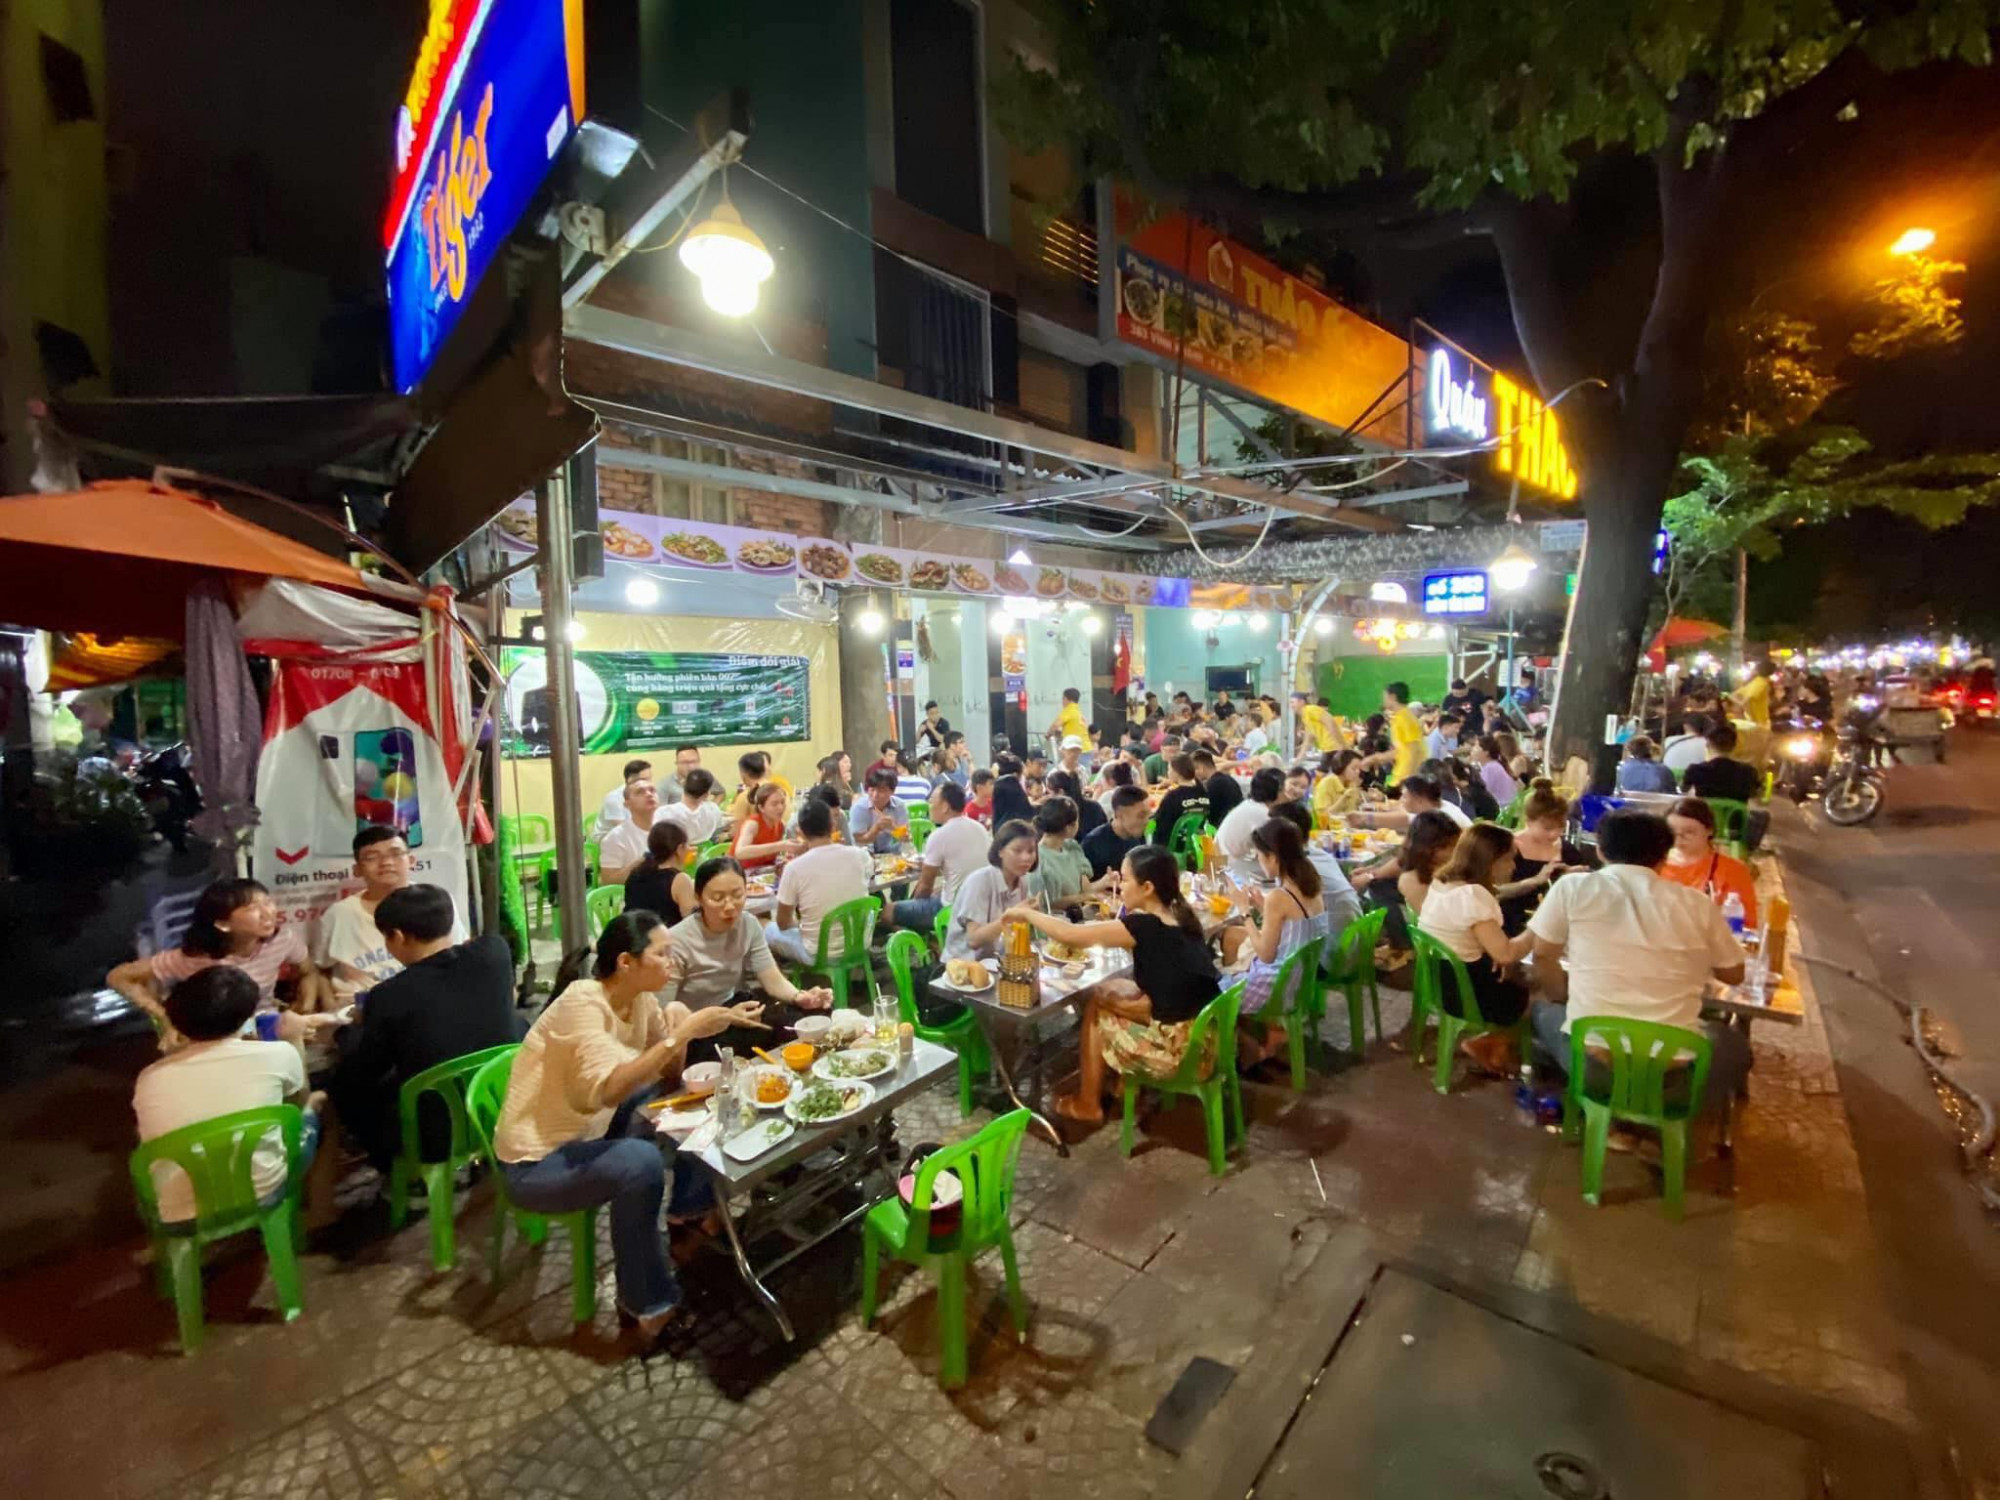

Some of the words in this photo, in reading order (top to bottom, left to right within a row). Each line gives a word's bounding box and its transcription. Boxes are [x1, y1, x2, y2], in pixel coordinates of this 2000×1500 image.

[421, 81, 493, 303] Tiger
[275, 872, 310, 885] Điện
[313, 868, 350, 882] thoại
[411, 860, 432, 872] 51
[276, 908, 328, 924] 5.97
